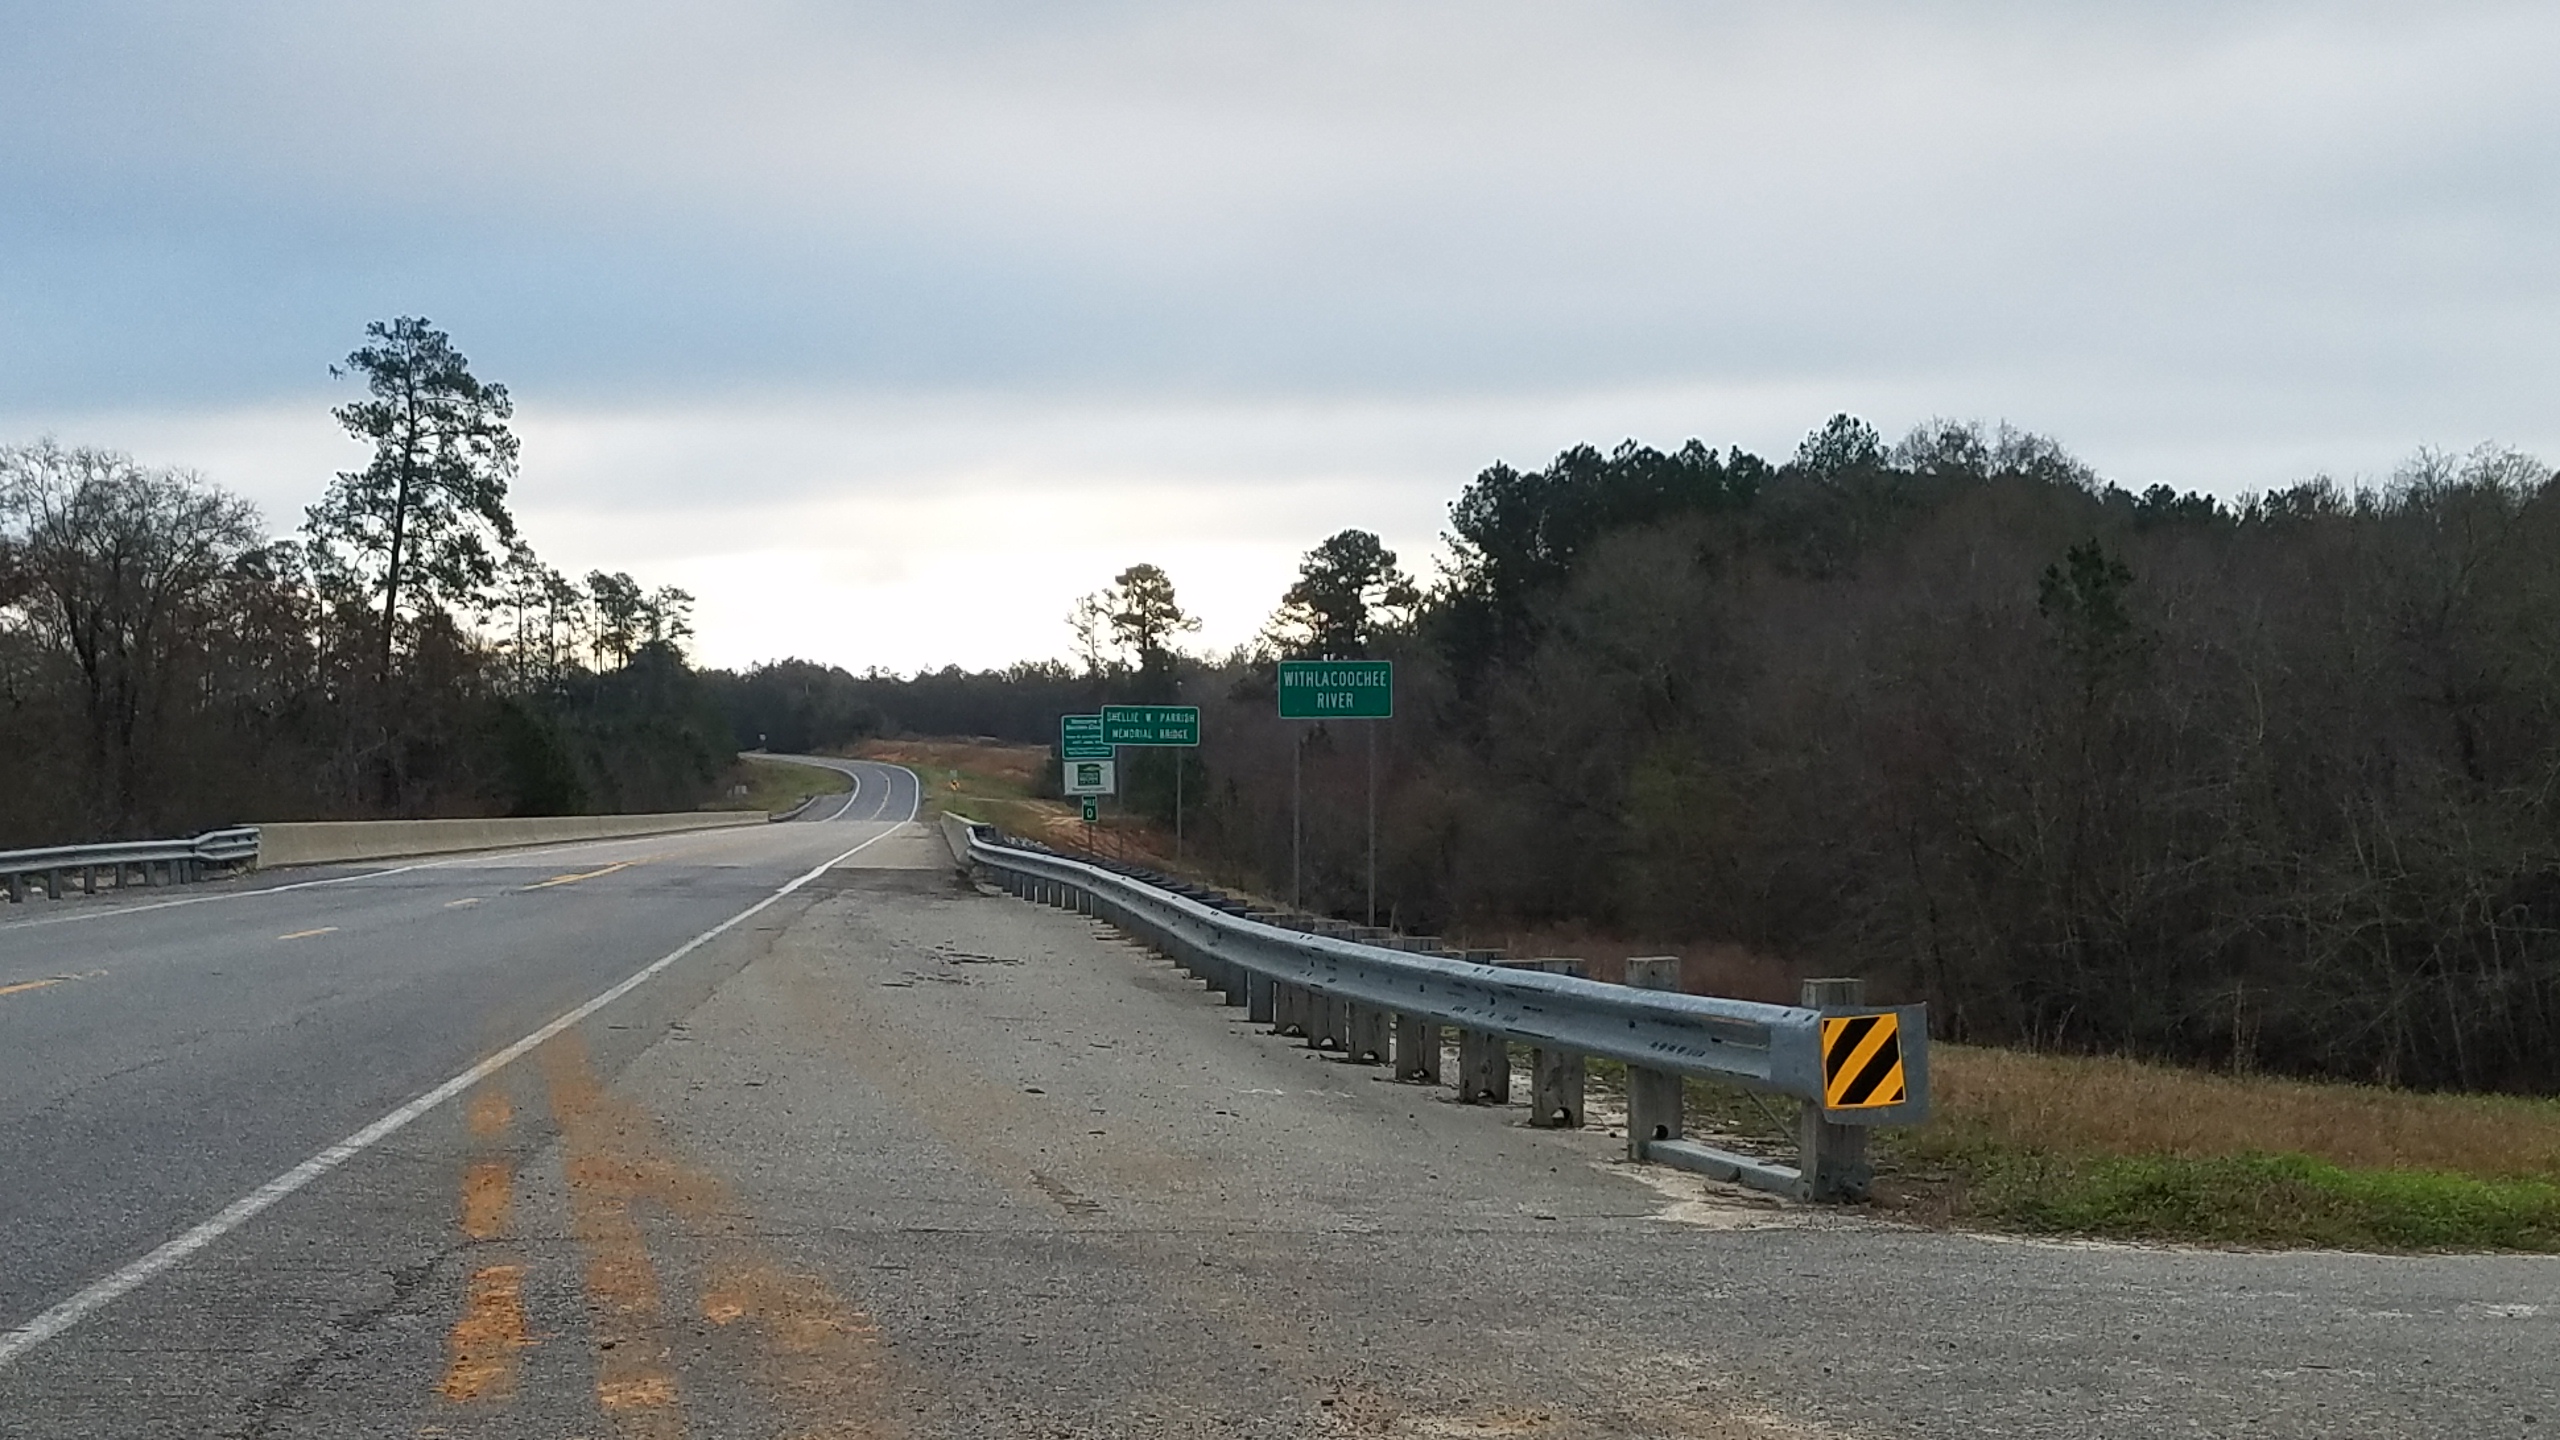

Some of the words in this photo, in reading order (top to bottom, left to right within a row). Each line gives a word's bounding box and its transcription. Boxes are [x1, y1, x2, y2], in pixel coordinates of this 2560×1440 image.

[1283, 671, 1387, 687] WITHLACOOCHEE
[1317, 692, 1354, 708] RIVER
[1112, 729, 1152, 739] MEMORIAL
[1159, 729, 1188, 739] BRIDGE
[1086, 808, 1093, 819] 0
